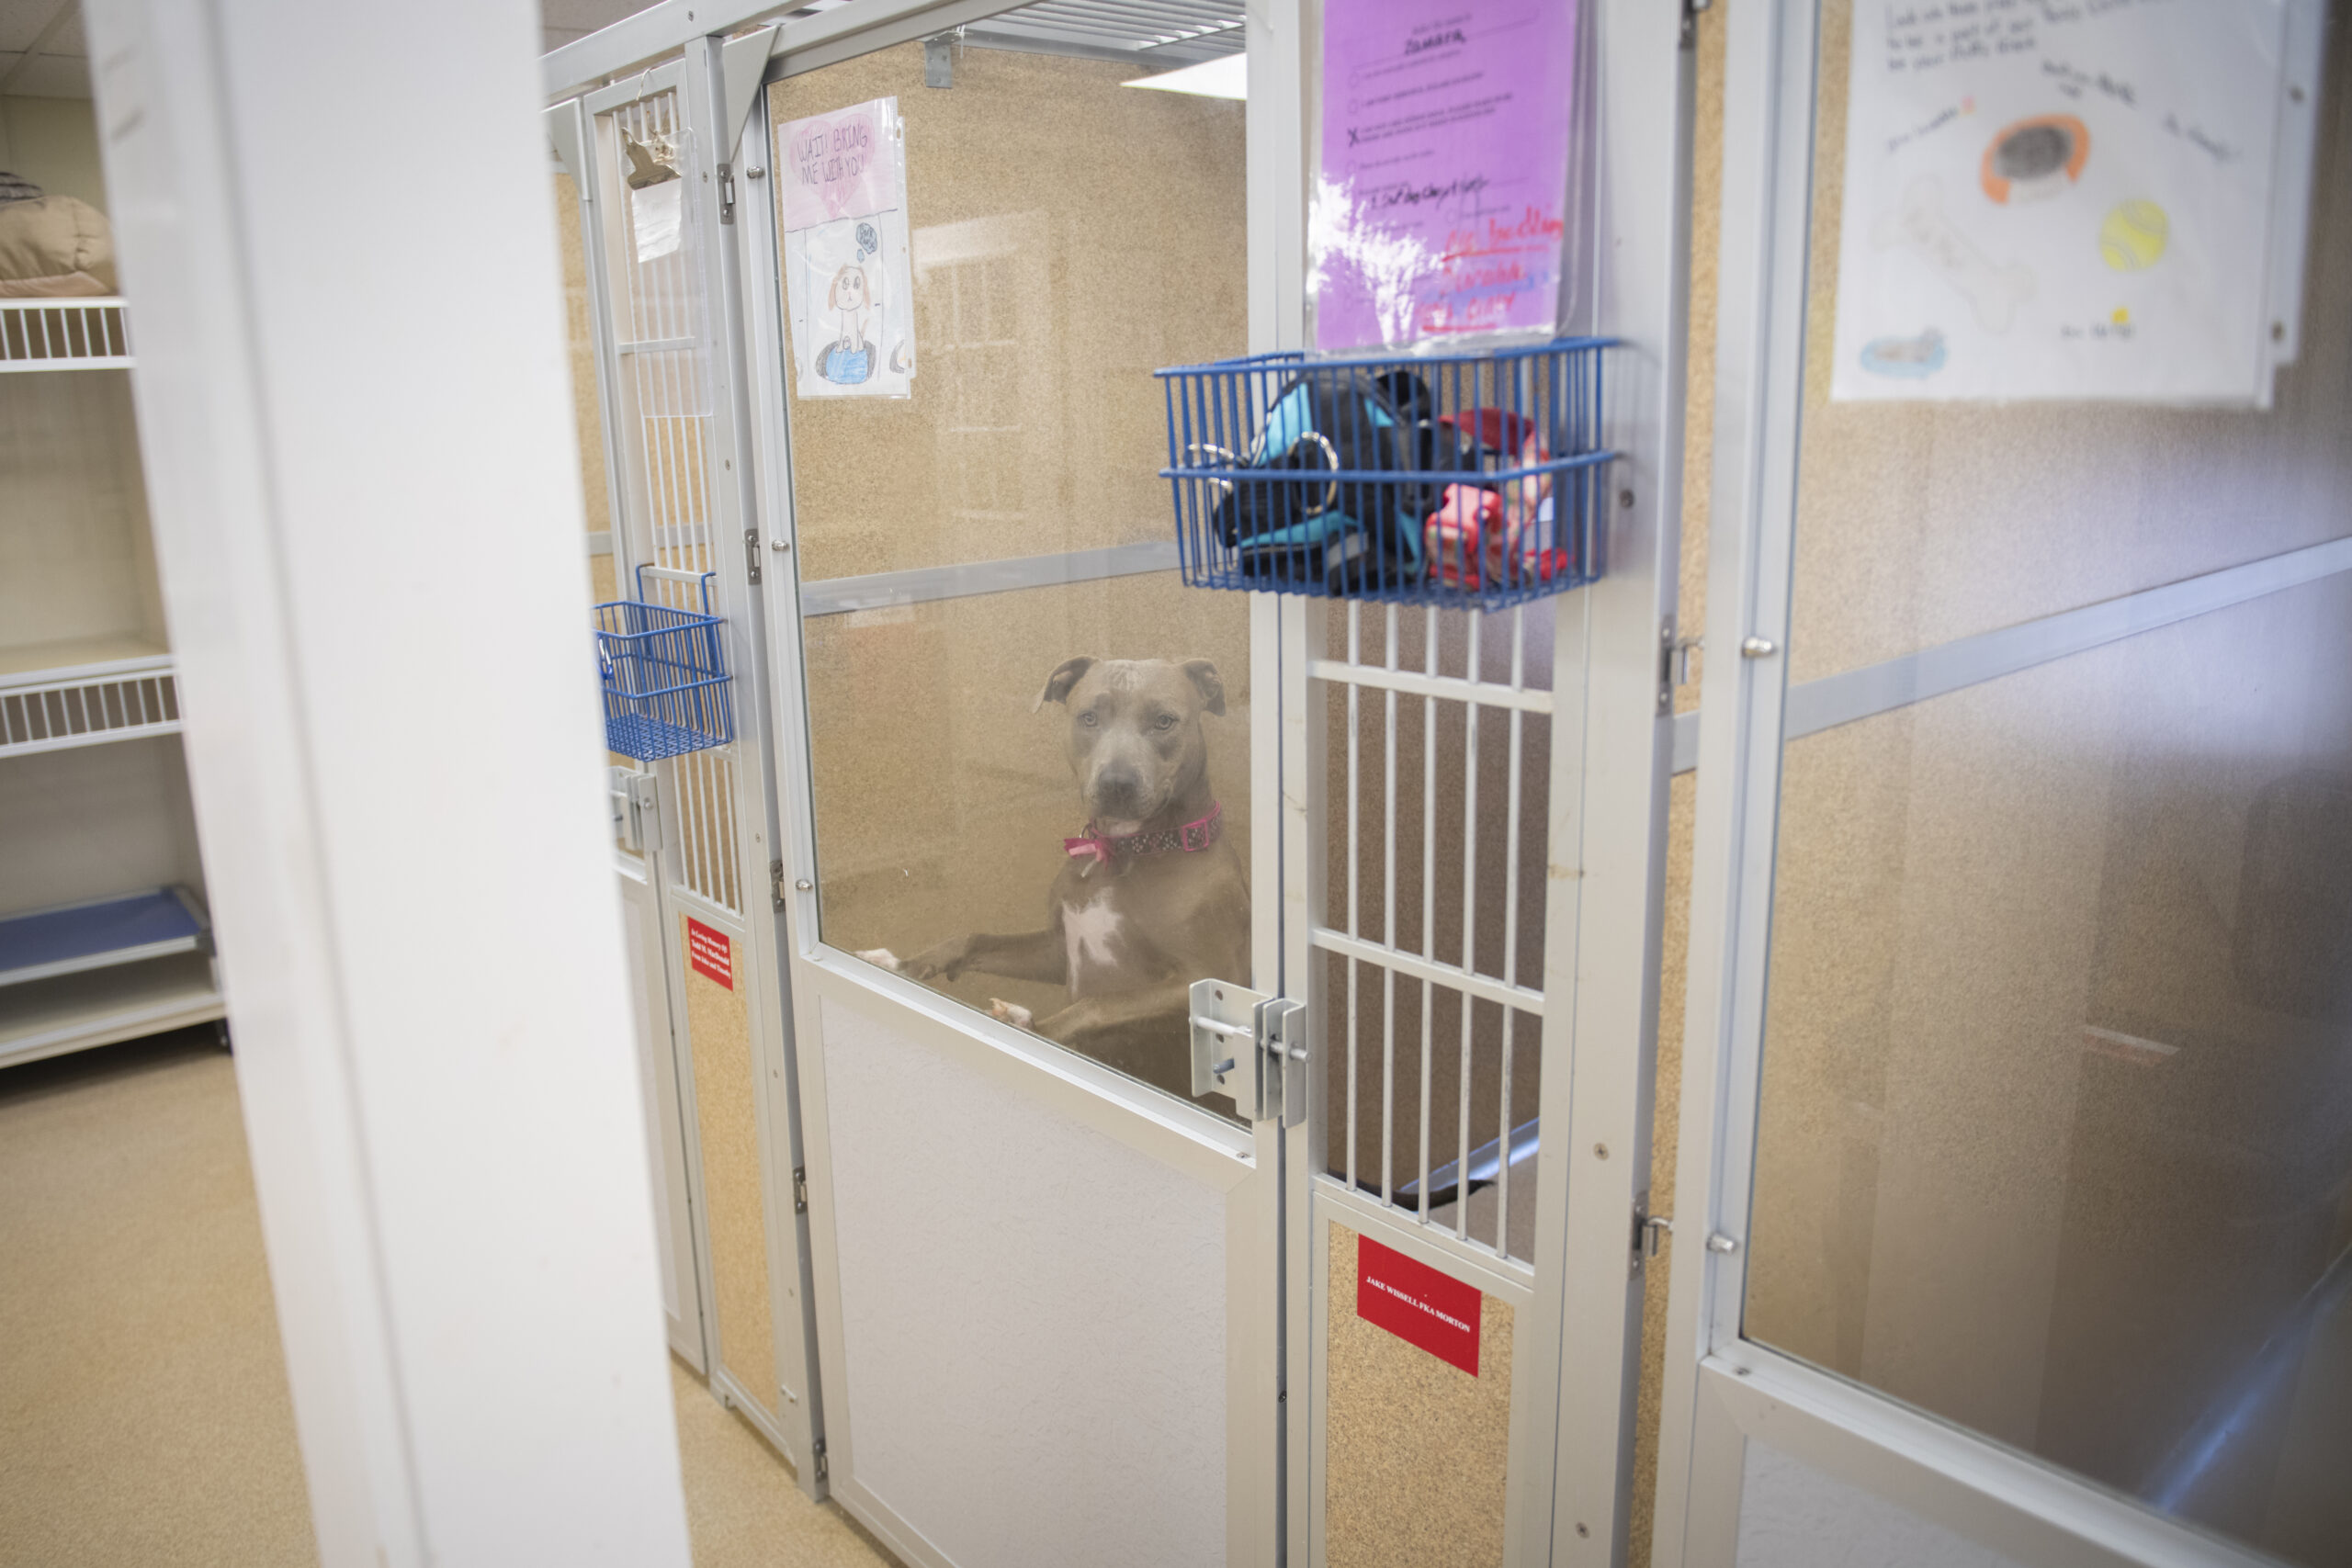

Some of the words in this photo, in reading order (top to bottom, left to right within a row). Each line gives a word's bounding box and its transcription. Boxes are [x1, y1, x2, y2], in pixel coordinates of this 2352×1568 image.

[833, 123, 868, 152] BRING
[801, 161, 819, 185] ME
[822, 155, 844, 183] WITH
[844, 153, 865, 177] YOU
[1366, 1276, 1386, 1292] JAKE
[1386, 1285, 1419, 1307] WISSELL
[1419, 1302, 1435, 1316] FKA
[1435, 1310, 1471, 1333] MORTON
